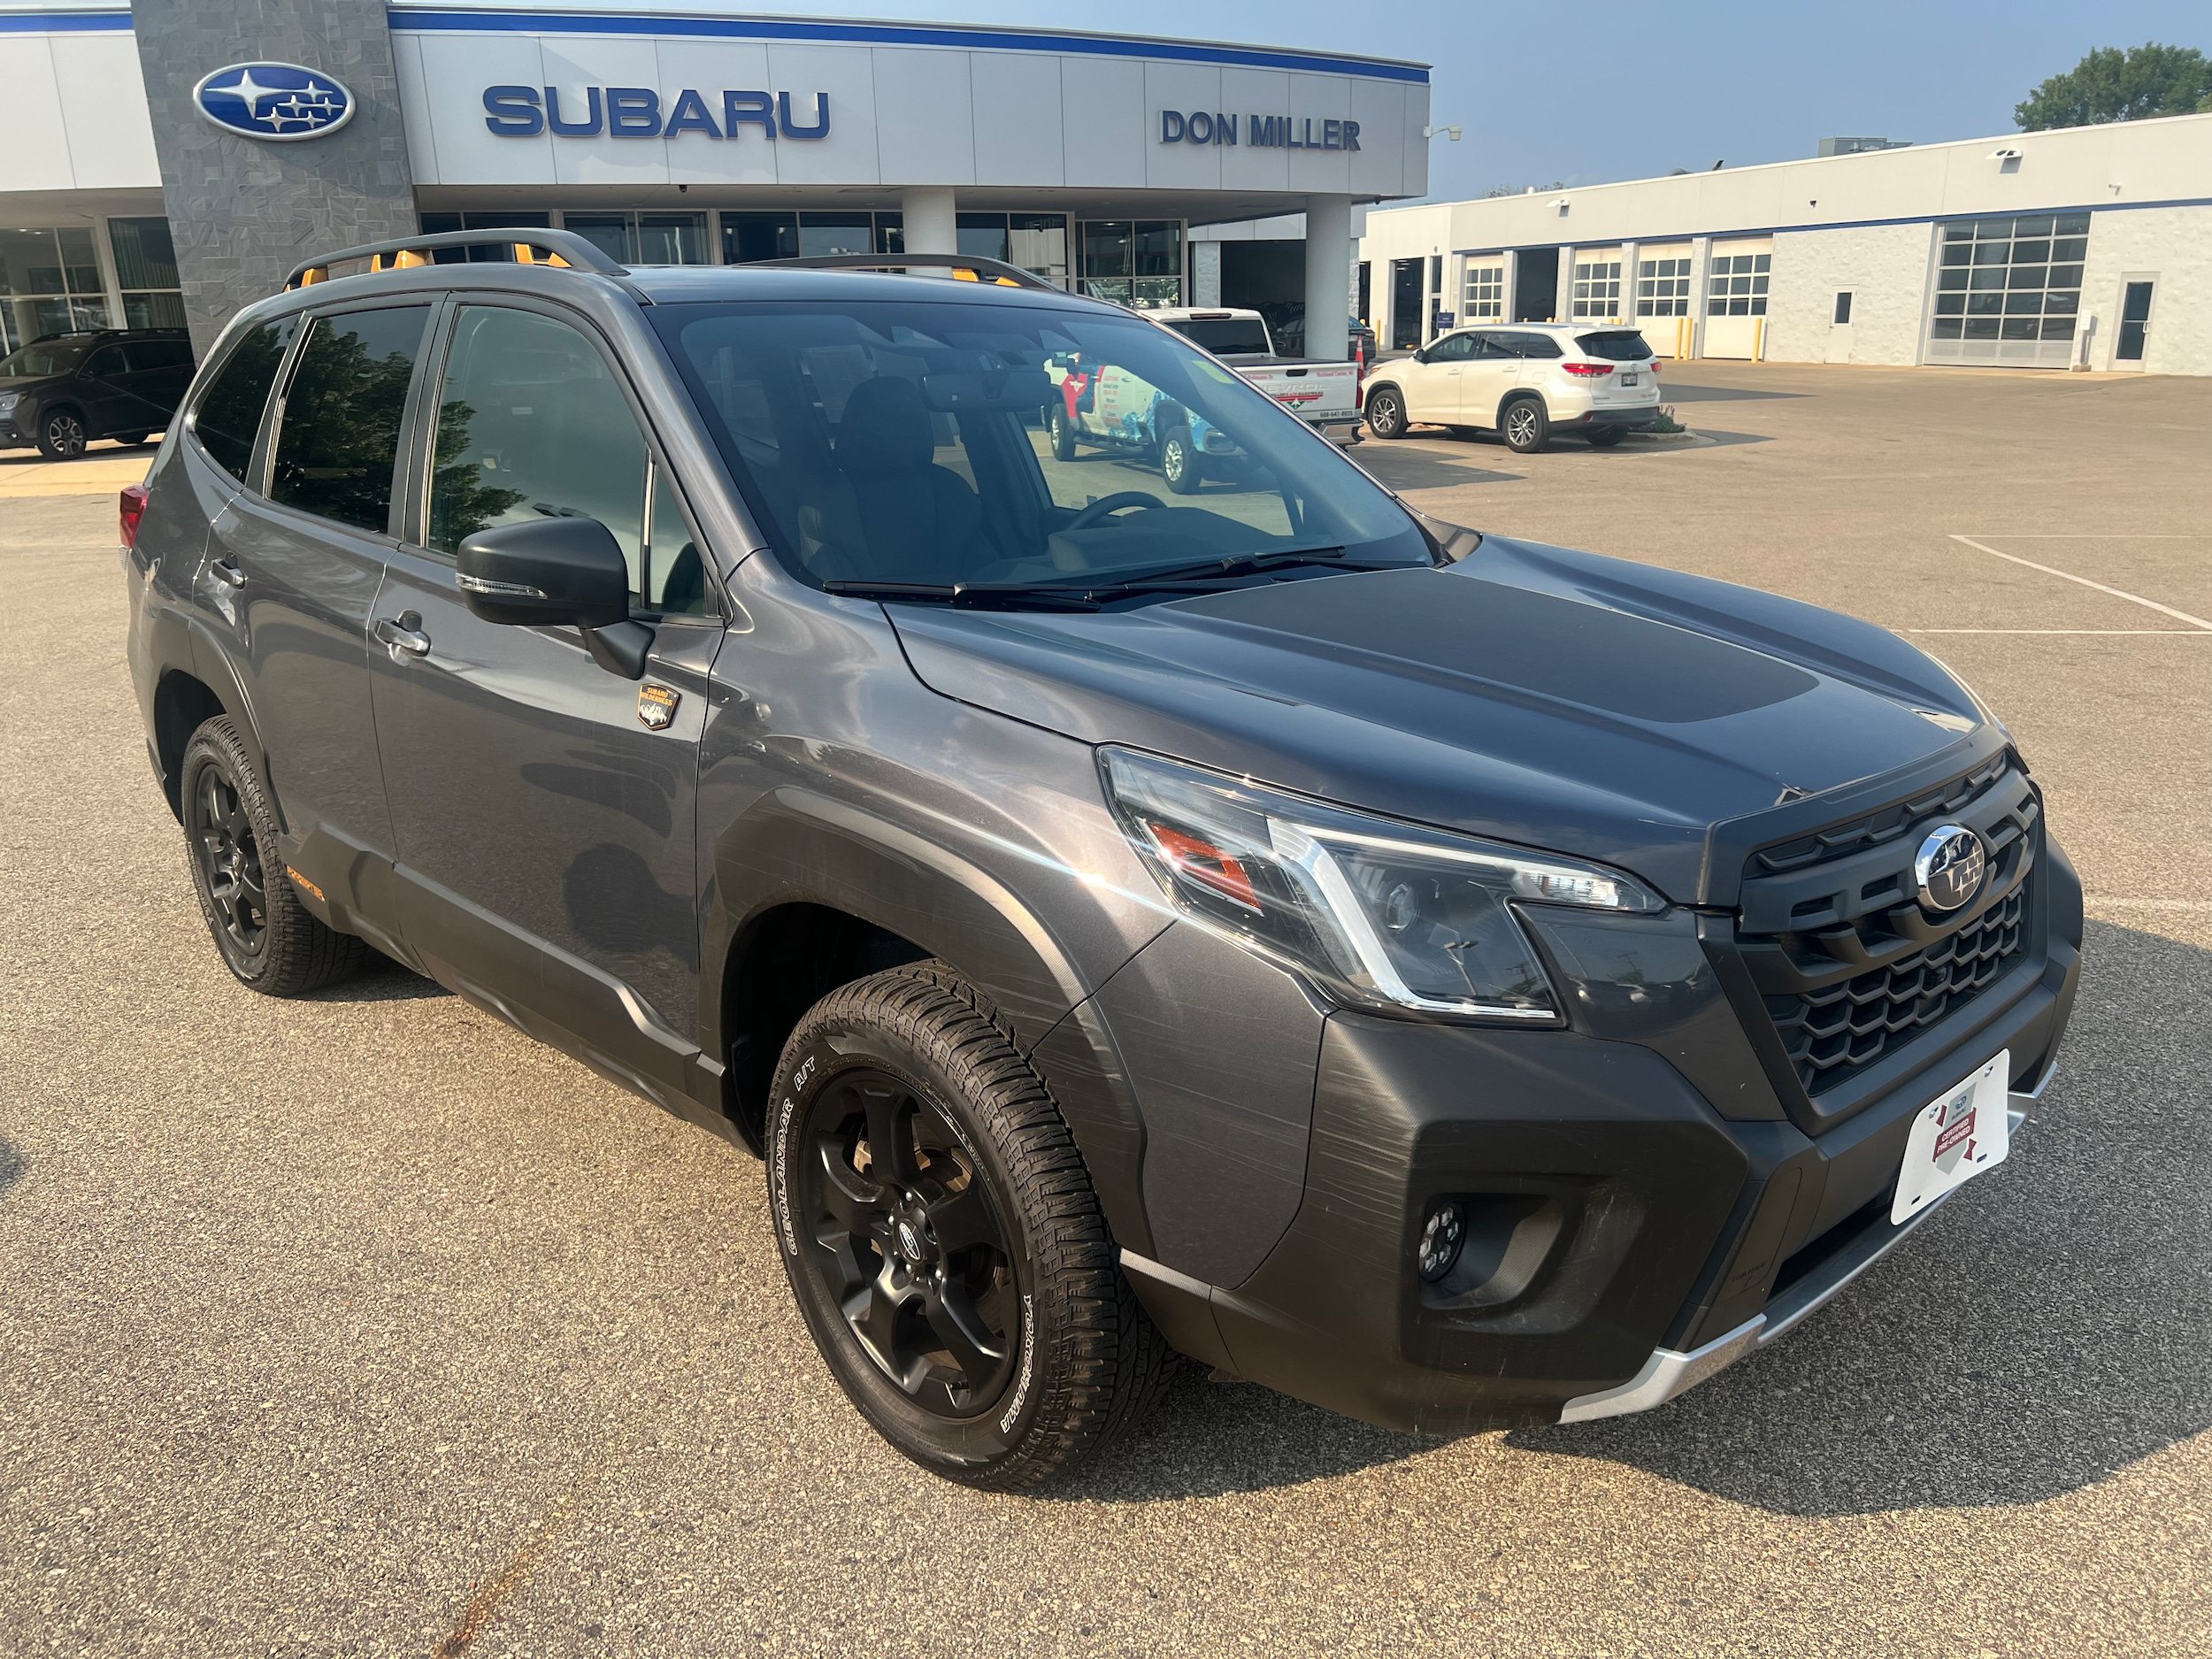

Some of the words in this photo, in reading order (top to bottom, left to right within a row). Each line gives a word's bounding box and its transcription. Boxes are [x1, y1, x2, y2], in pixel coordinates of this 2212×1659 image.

[482, 85, 832, 140] SUBARU
[1159, 110, 1238, 146] DON
[1247, 114, 1362, 151] MILLER
[640, 691, 673, 706] WILDERNESS
[647, 687, 669, 698] SUBARU
[1937, 1125, 1970, 1154] PRE-OWNED
[1941, 1118, 1970, 1142] CERTIFIED
[776, 1097, 798, 1256] GEOLANDAR
[794, 1056, 816, 1092] A/T
[1000, 1294, 1035, 1434] YOKOHAMA
